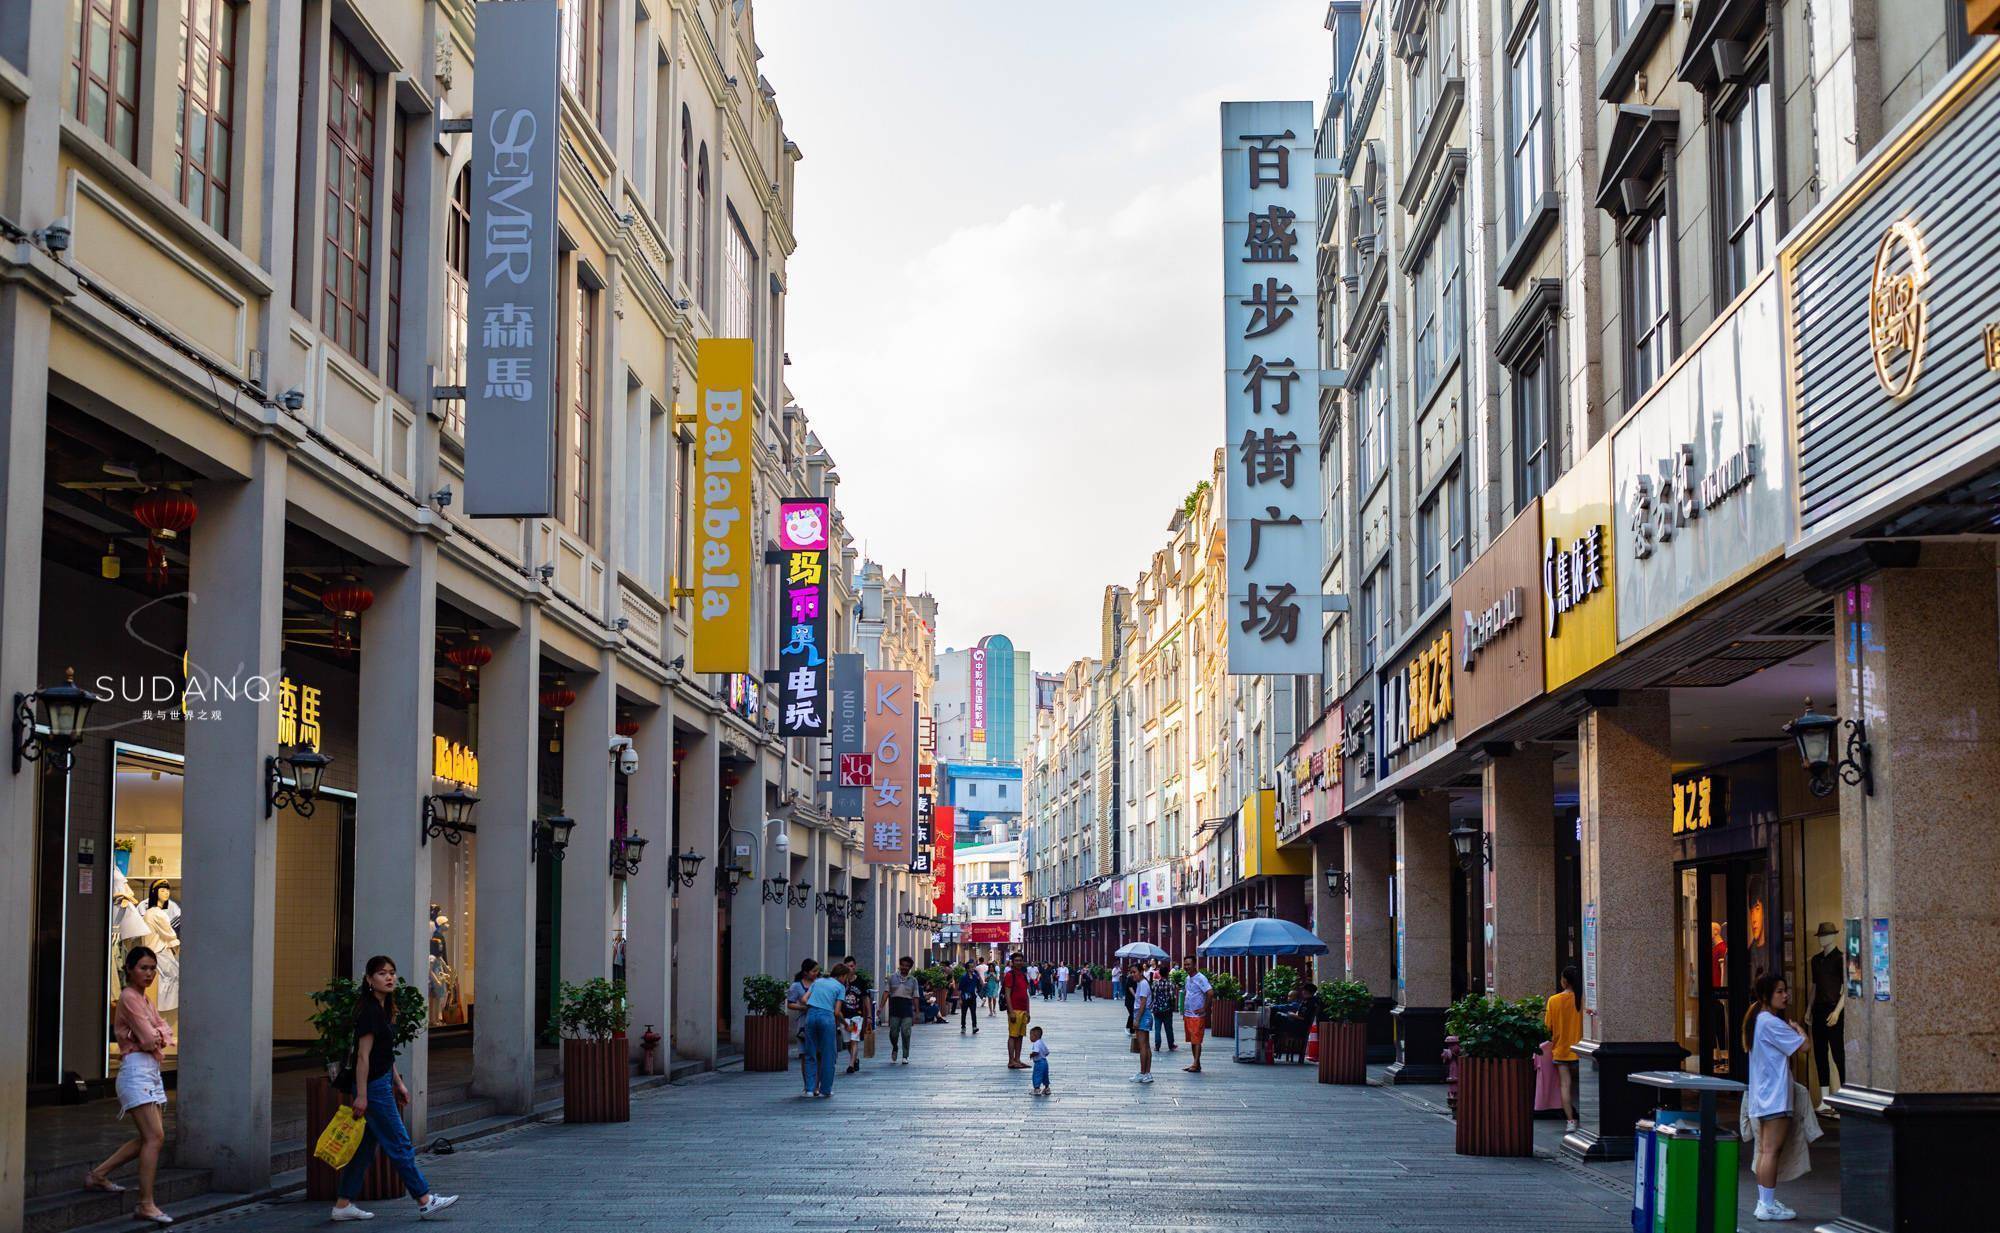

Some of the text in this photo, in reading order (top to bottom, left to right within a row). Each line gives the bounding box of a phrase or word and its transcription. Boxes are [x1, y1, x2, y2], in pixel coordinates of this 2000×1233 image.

[483, 108, 537, 402] SEMIR 森馬
[1239, 129, 1303, 645] 百盛步行街广场
[702, 388, 743, 621] Balabala
[780, 552, 826, 731] 玛丽奥电玩
[1383, 668, 1408, 758] HLA
[1408, 630, 1453, 742] 海澜之家
[874, 683, 903, 851] K6女鞋
